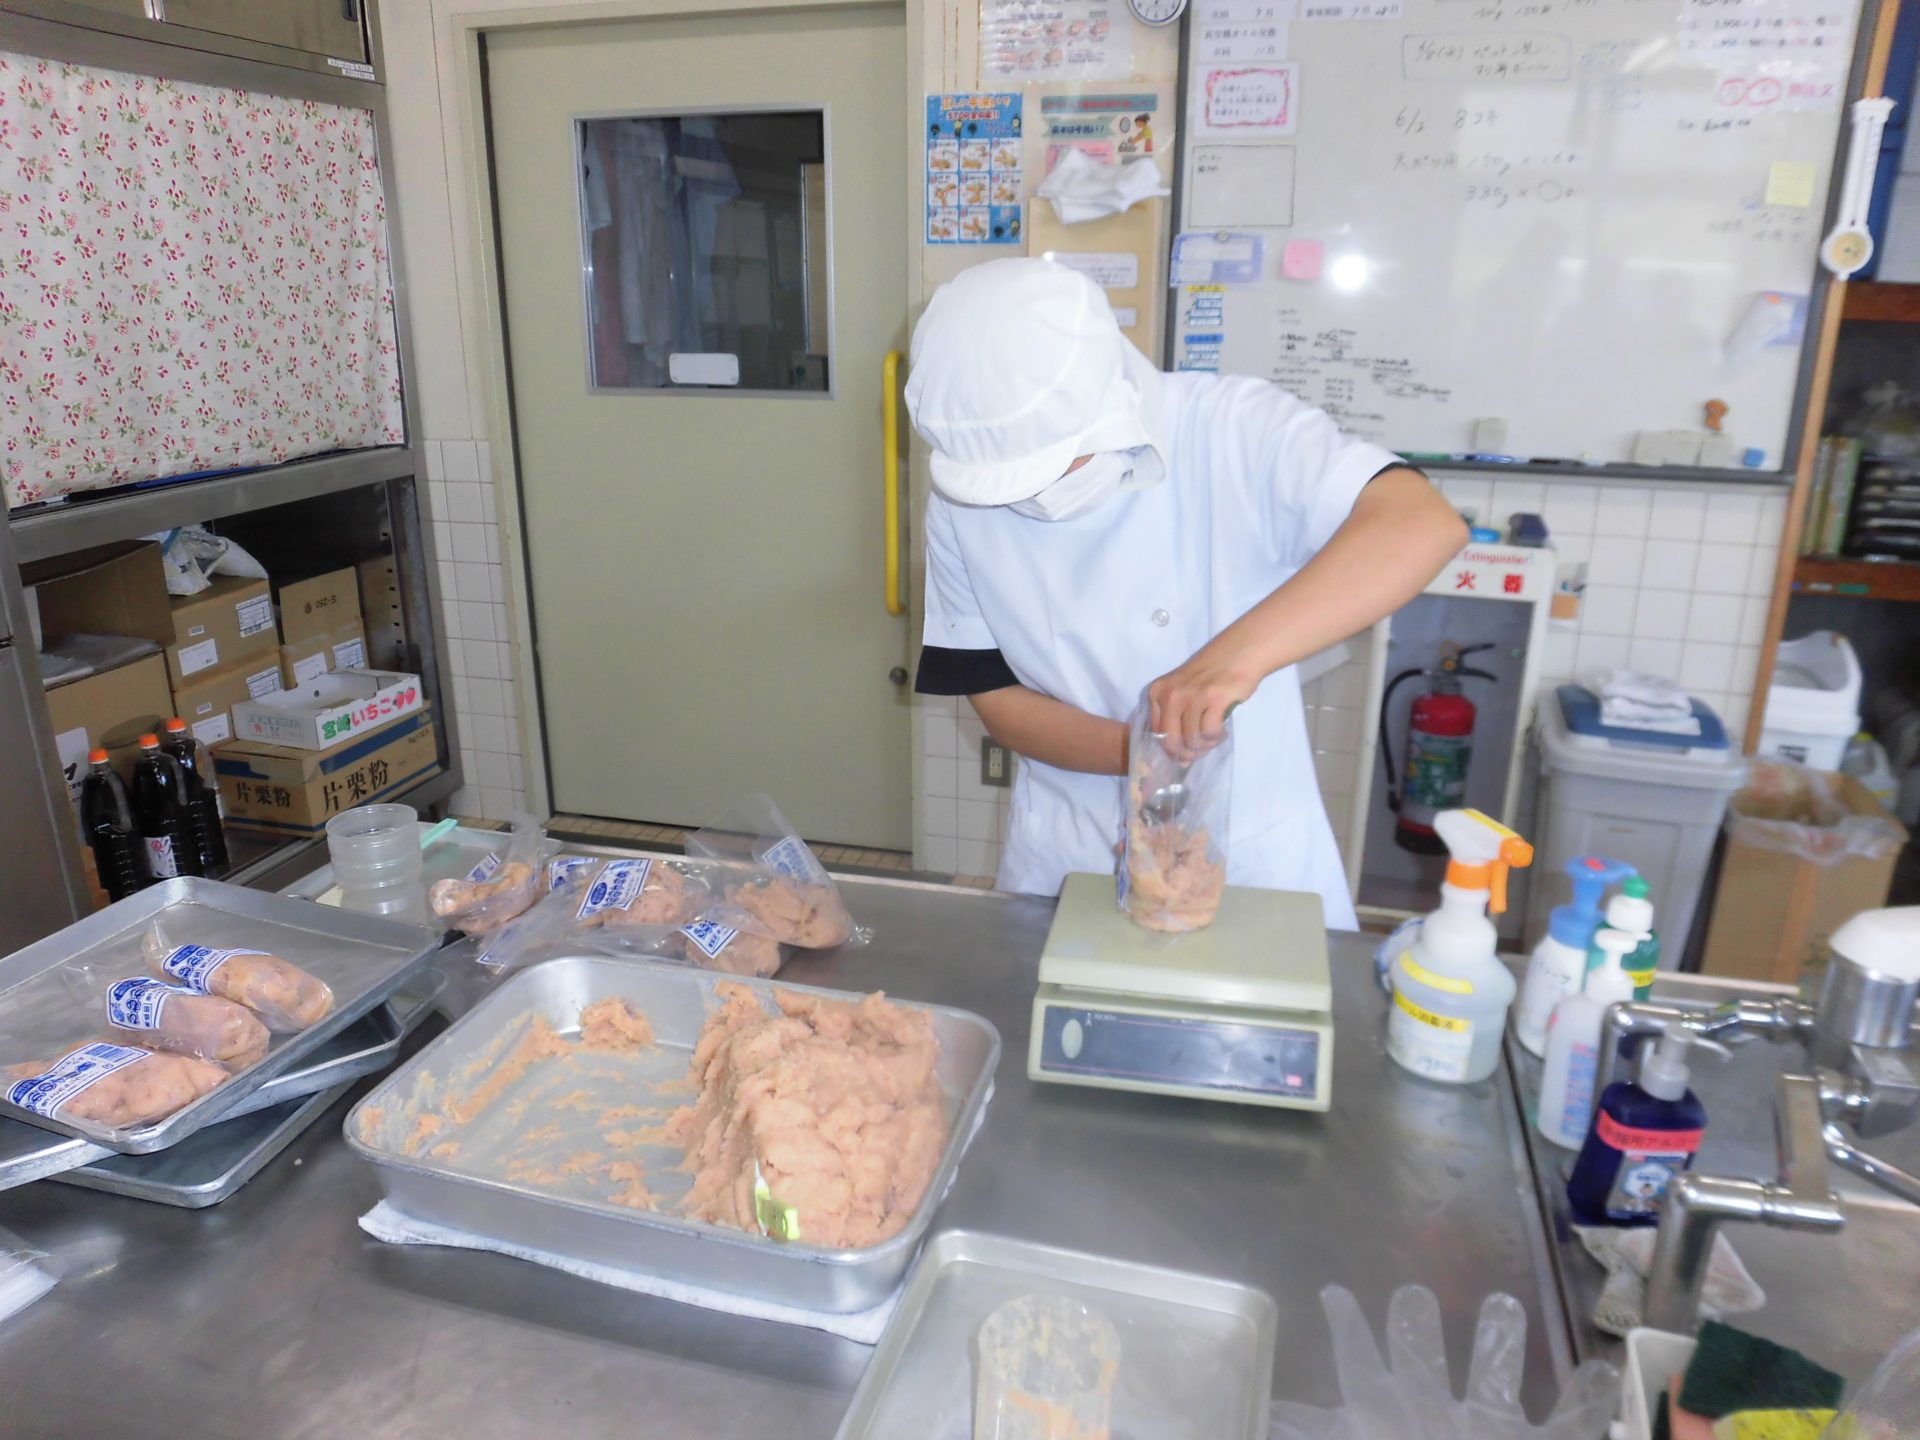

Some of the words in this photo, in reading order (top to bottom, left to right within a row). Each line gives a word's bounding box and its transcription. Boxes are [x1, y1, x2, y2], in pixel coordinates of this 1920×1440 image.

[236, 782, 291, 807] 片栗粉
[322, 760, 390, 814] 片栗粉
